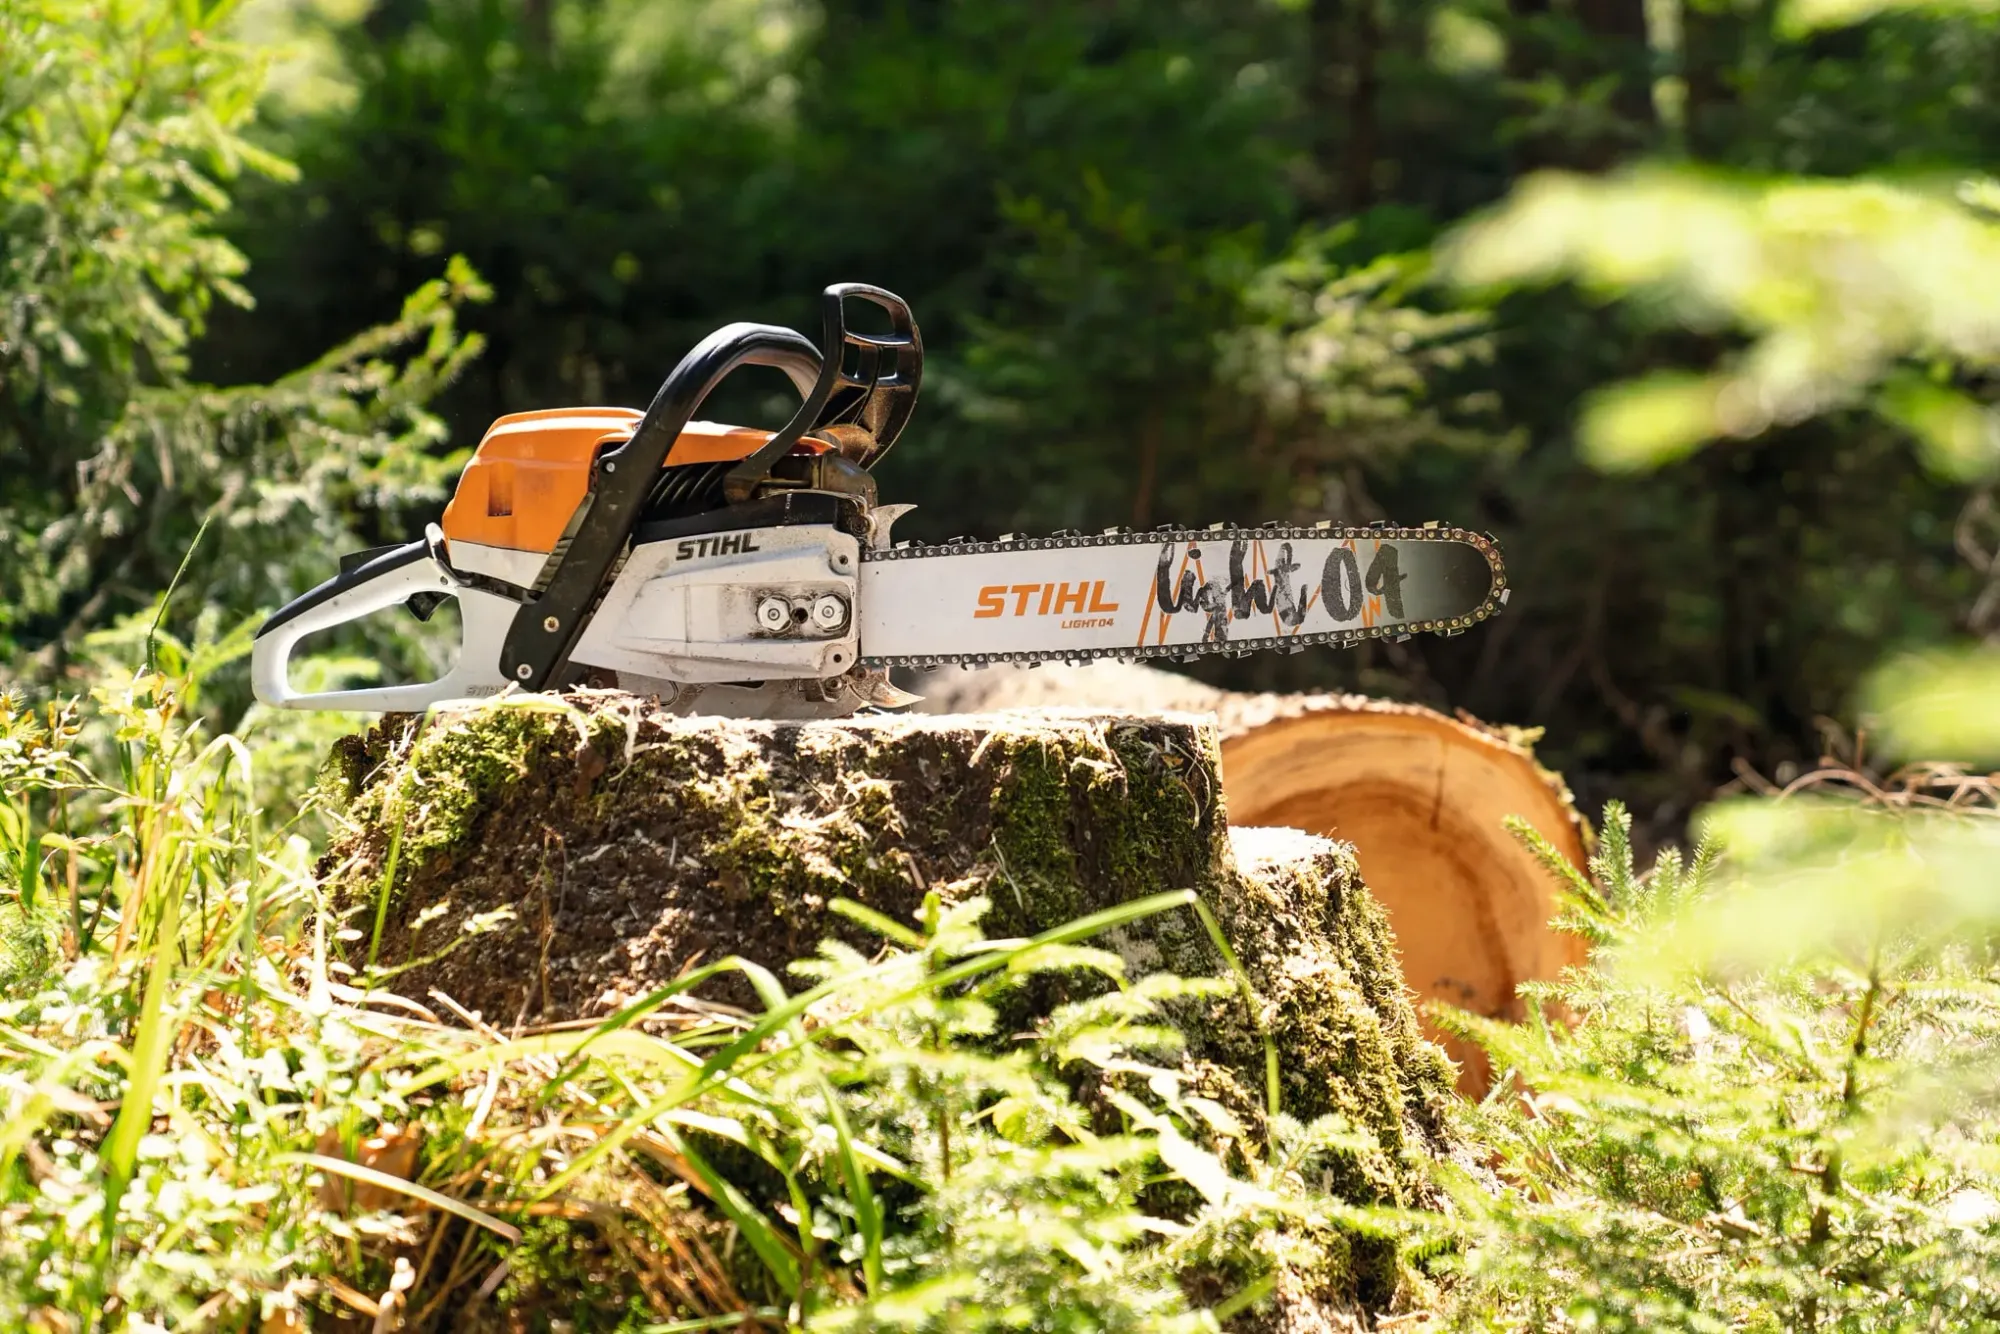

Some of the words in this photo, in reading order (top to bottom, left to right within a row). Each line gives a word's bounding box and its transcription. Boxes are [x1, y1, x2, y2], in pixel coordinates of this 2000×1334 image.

[676, 532, 760, 561] STIHL
[974, 580, 1120, 618] STIHL
[1157, 540, 1308, 643] light
